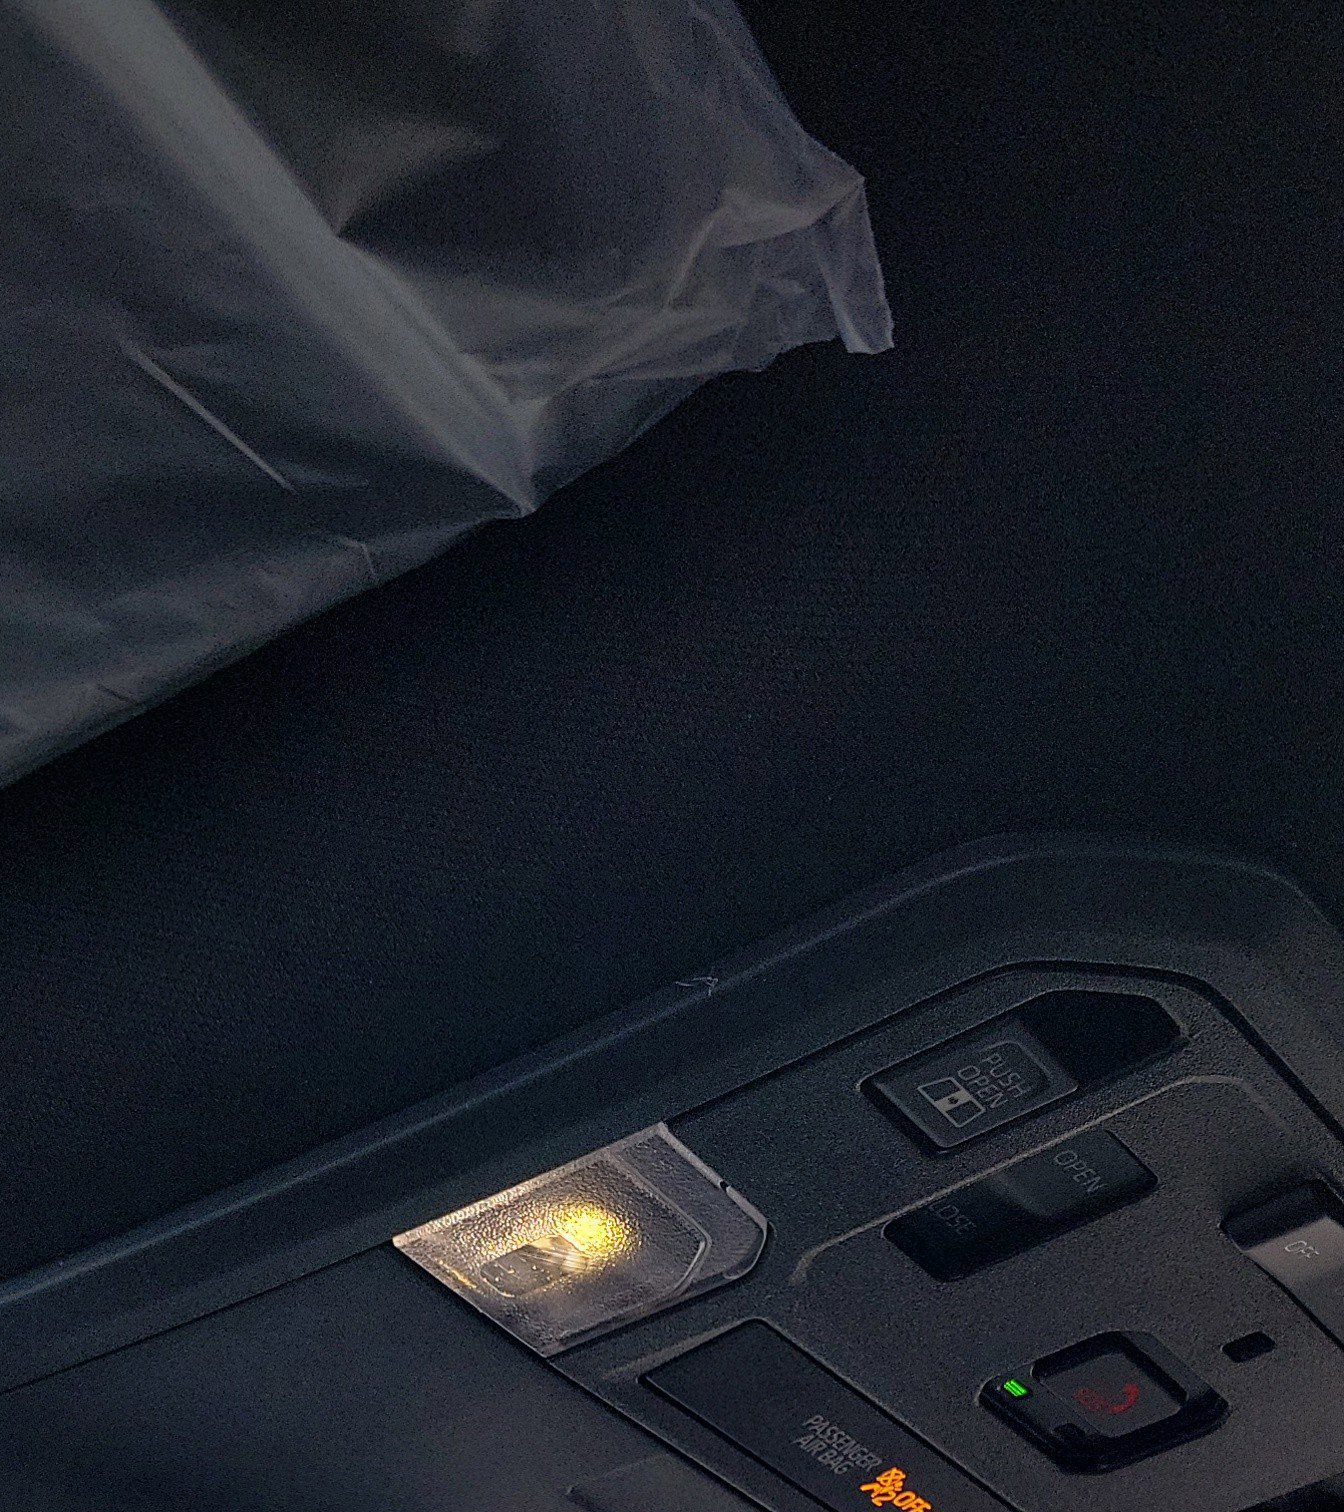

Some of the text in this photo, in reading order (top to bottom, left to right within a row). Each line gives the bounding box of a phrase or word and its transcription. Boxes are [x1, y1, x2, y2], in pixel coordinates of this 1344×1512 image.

[957, 1065, 1009, 1109] OPEN
[982, 1052, 1032, 1098] PUSH
[1054, 1150, 1108, 1193] OPEN
[792, 1434, 855, 1475] AIR BAG
[802, 1414, 883, 1473] PASSENGER
